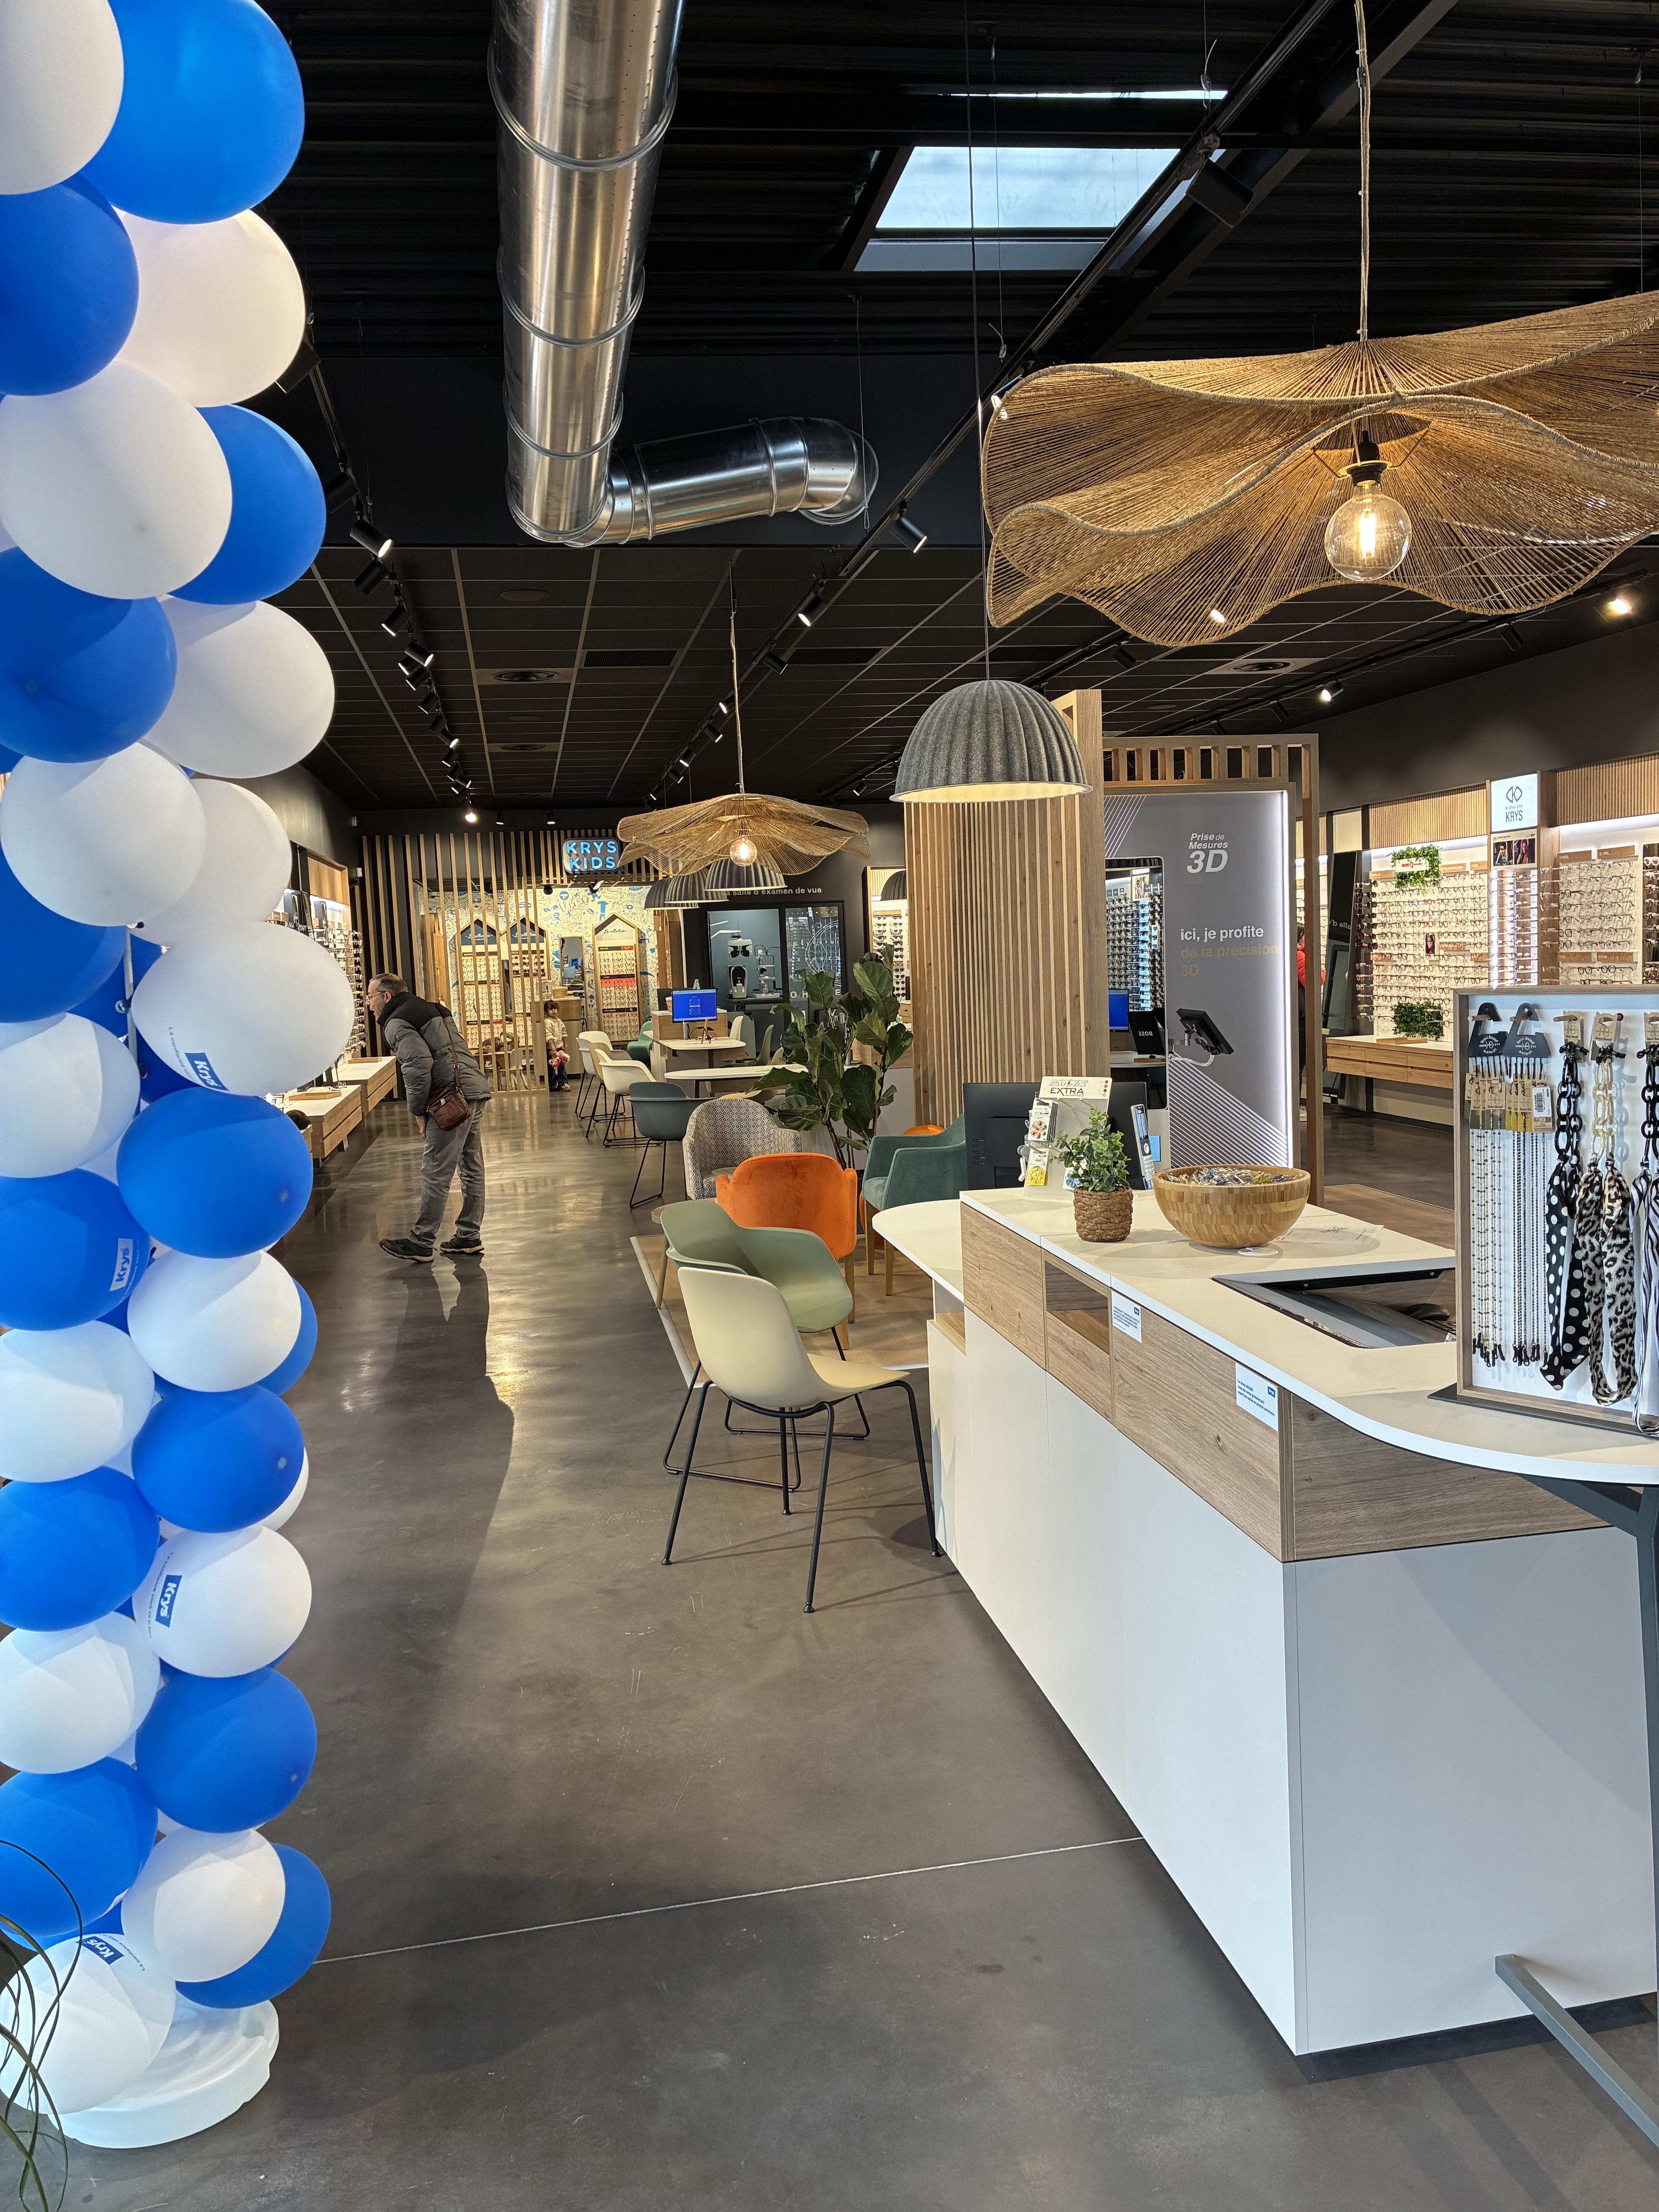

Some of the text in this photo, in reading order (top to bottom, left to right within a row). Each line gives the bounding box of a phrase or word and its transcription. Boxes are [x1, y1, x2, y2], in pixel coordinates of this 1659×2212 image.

[1505, 810, 1523, 823] KRYS
[566, 841, 617, 855] KRYS
[569, 856, 615, 870] KIDS
[1187, 849, 1228, 873] 3D
[1180, 926, 1264, 942] ici, je profite
[1181, 947, 1197, 958] de
[1202, 946, 1213, 957] la
[1182, 964, 1198, 976] 3D
[193, 1060, 219, 1087] Krys
[1050, 1087, 1084, 1096] EXTRA
[115, 1248, 130, 1282] Krys
[160, 1582, 177, 1617] Krys
[86, 1939, 115, 1958] Krys
